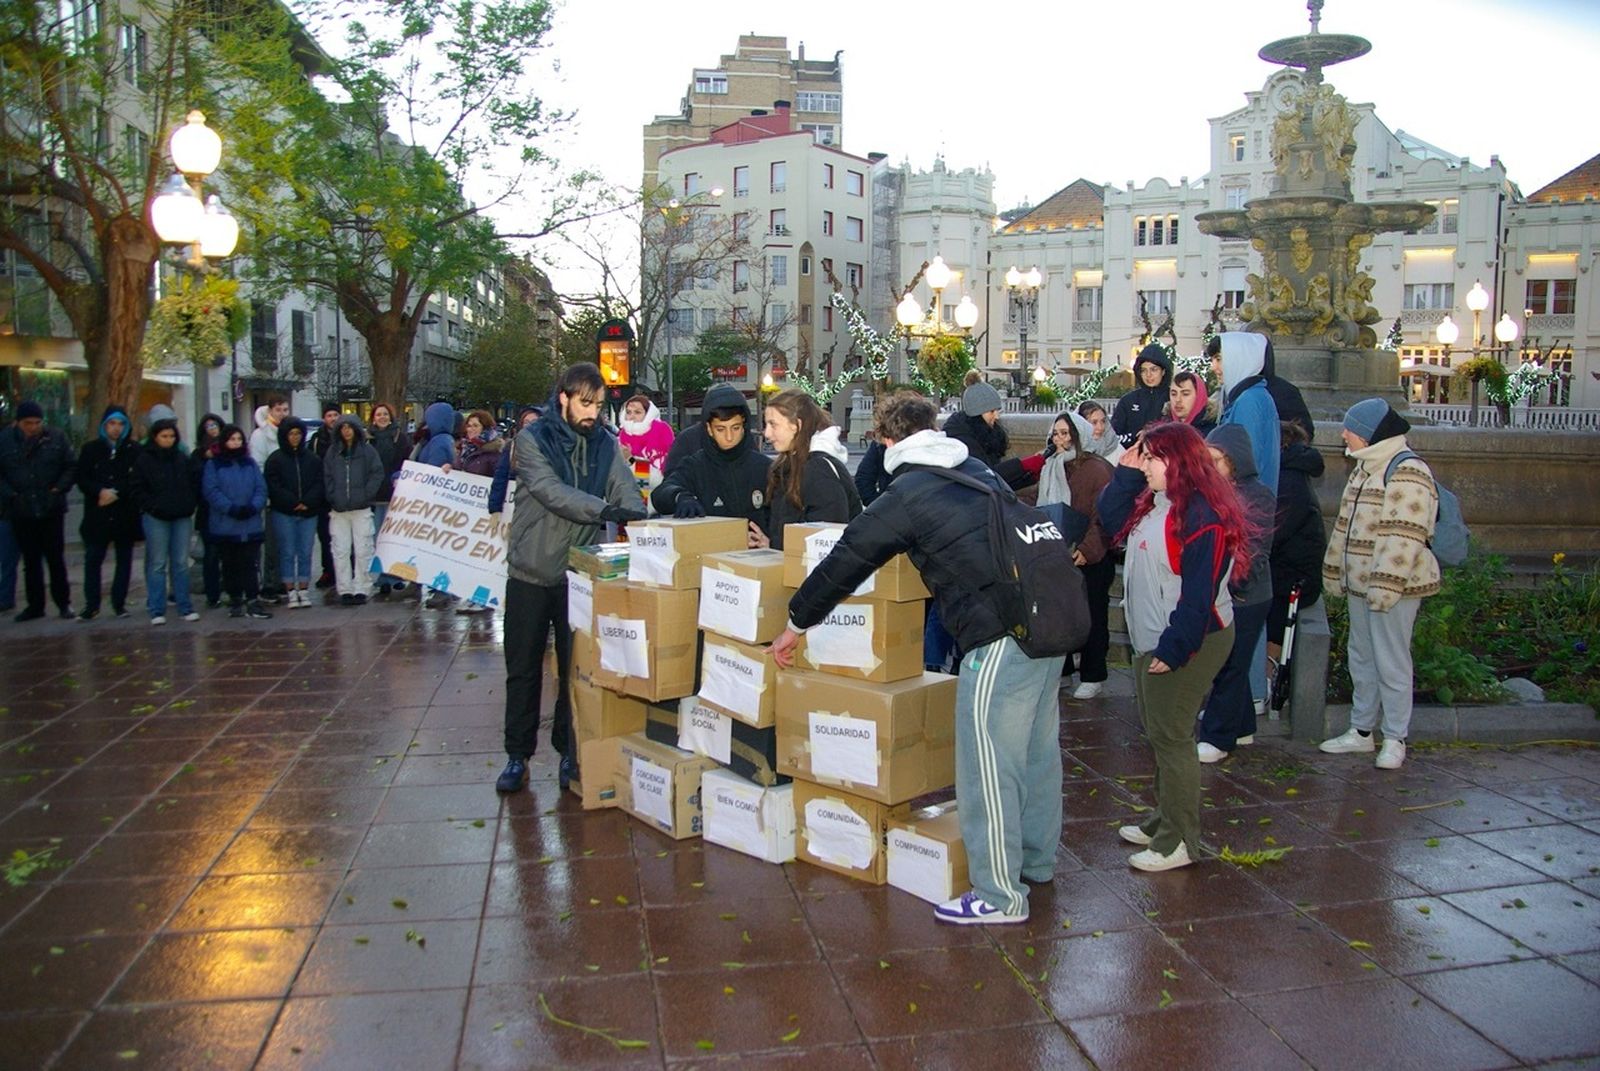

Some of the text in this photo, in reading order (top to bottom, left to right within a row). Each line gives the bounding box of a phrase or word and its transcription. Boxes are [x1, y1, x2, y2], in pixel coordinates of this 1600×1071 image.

[414, 471, 468, 494] CONSEJO
[381, 516, 469, 551] VIMIENTO
[469, 540, 502, 562] EN
[715, 581, 740, 594] APOYO
[714, 593, 739, 606] MUTUO
[602, 625, 638, 640] LIBERTAD
[715, 654, 753, 676] ESPERANZA
[690, 706, 720, 721] JUSTICIA
[691, 718, 717, 732] SOCIAL
[815, 724, 871, 740] SOLIDARIDAD
[639, 780, 663, 796] DE CLASE
[717, 794, 734, 806] BIEN
[894, 838, 941, 860] COMPROMISO
